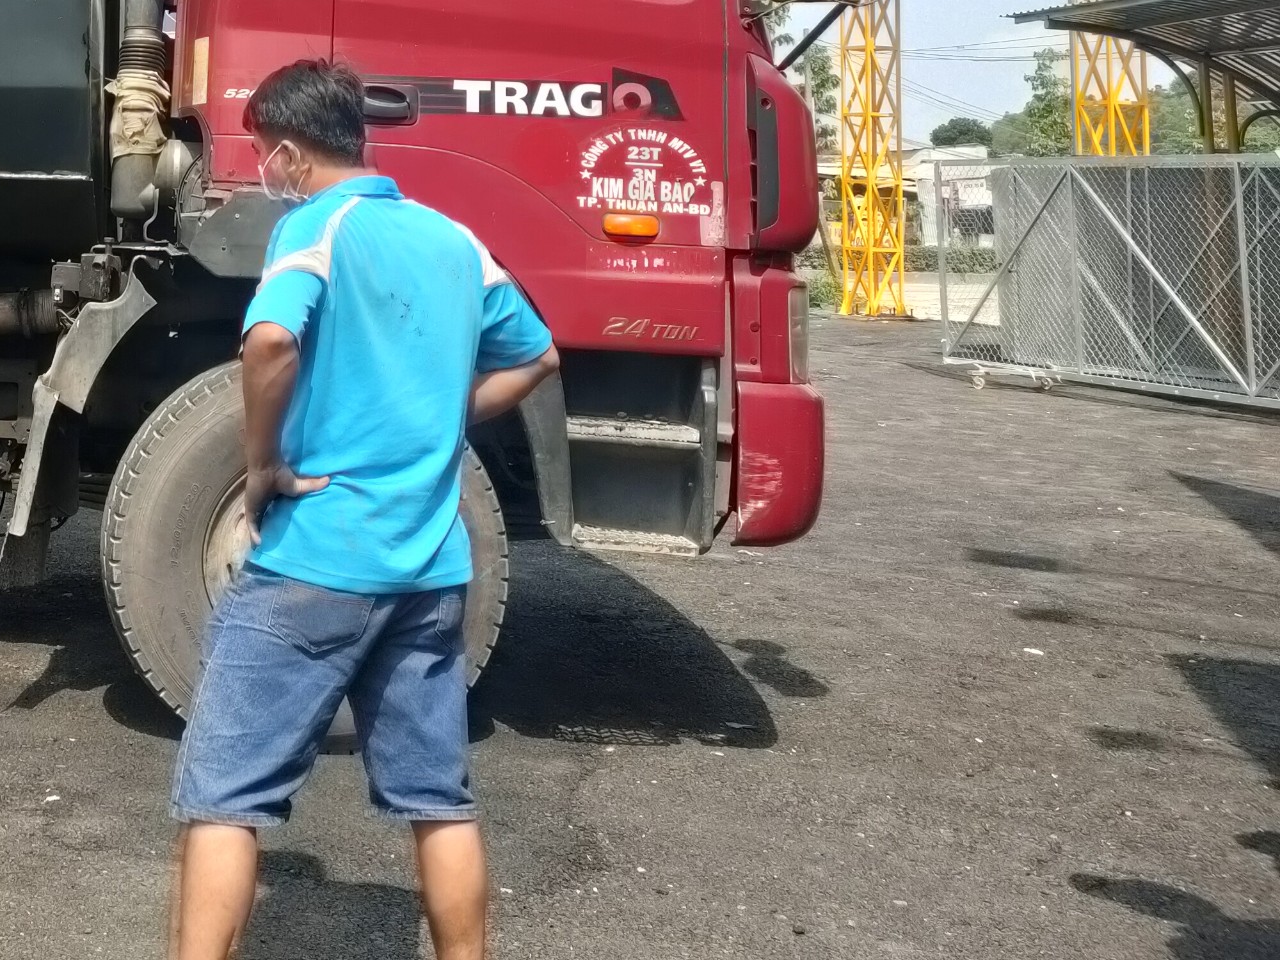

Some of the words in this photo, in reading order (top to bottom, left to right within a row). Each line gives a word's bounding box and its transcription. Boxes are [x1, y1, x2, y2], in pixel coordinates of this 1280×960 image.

[454, 80, 653, 117] TRAGO
[580, 139, 610, 169] CÔNG
[606, 130, 625, 145] TY
[628, 129, 668, 144] TNHH
[668, 137, 697, 159] MTV
[689, 158, 707, 174] VT
[627, 146, 662, 161] 23T
[632, 168, 657, 182] 3N
[592, 177, 624, 199] KIM
[628, 180, 656, 201] GIA
[576, 196, 602, 209] TP.
[662, 202, 712, 215] AN-BD
[602, 316, 651, 337] 24
[652, 324, 700, 341] TON
